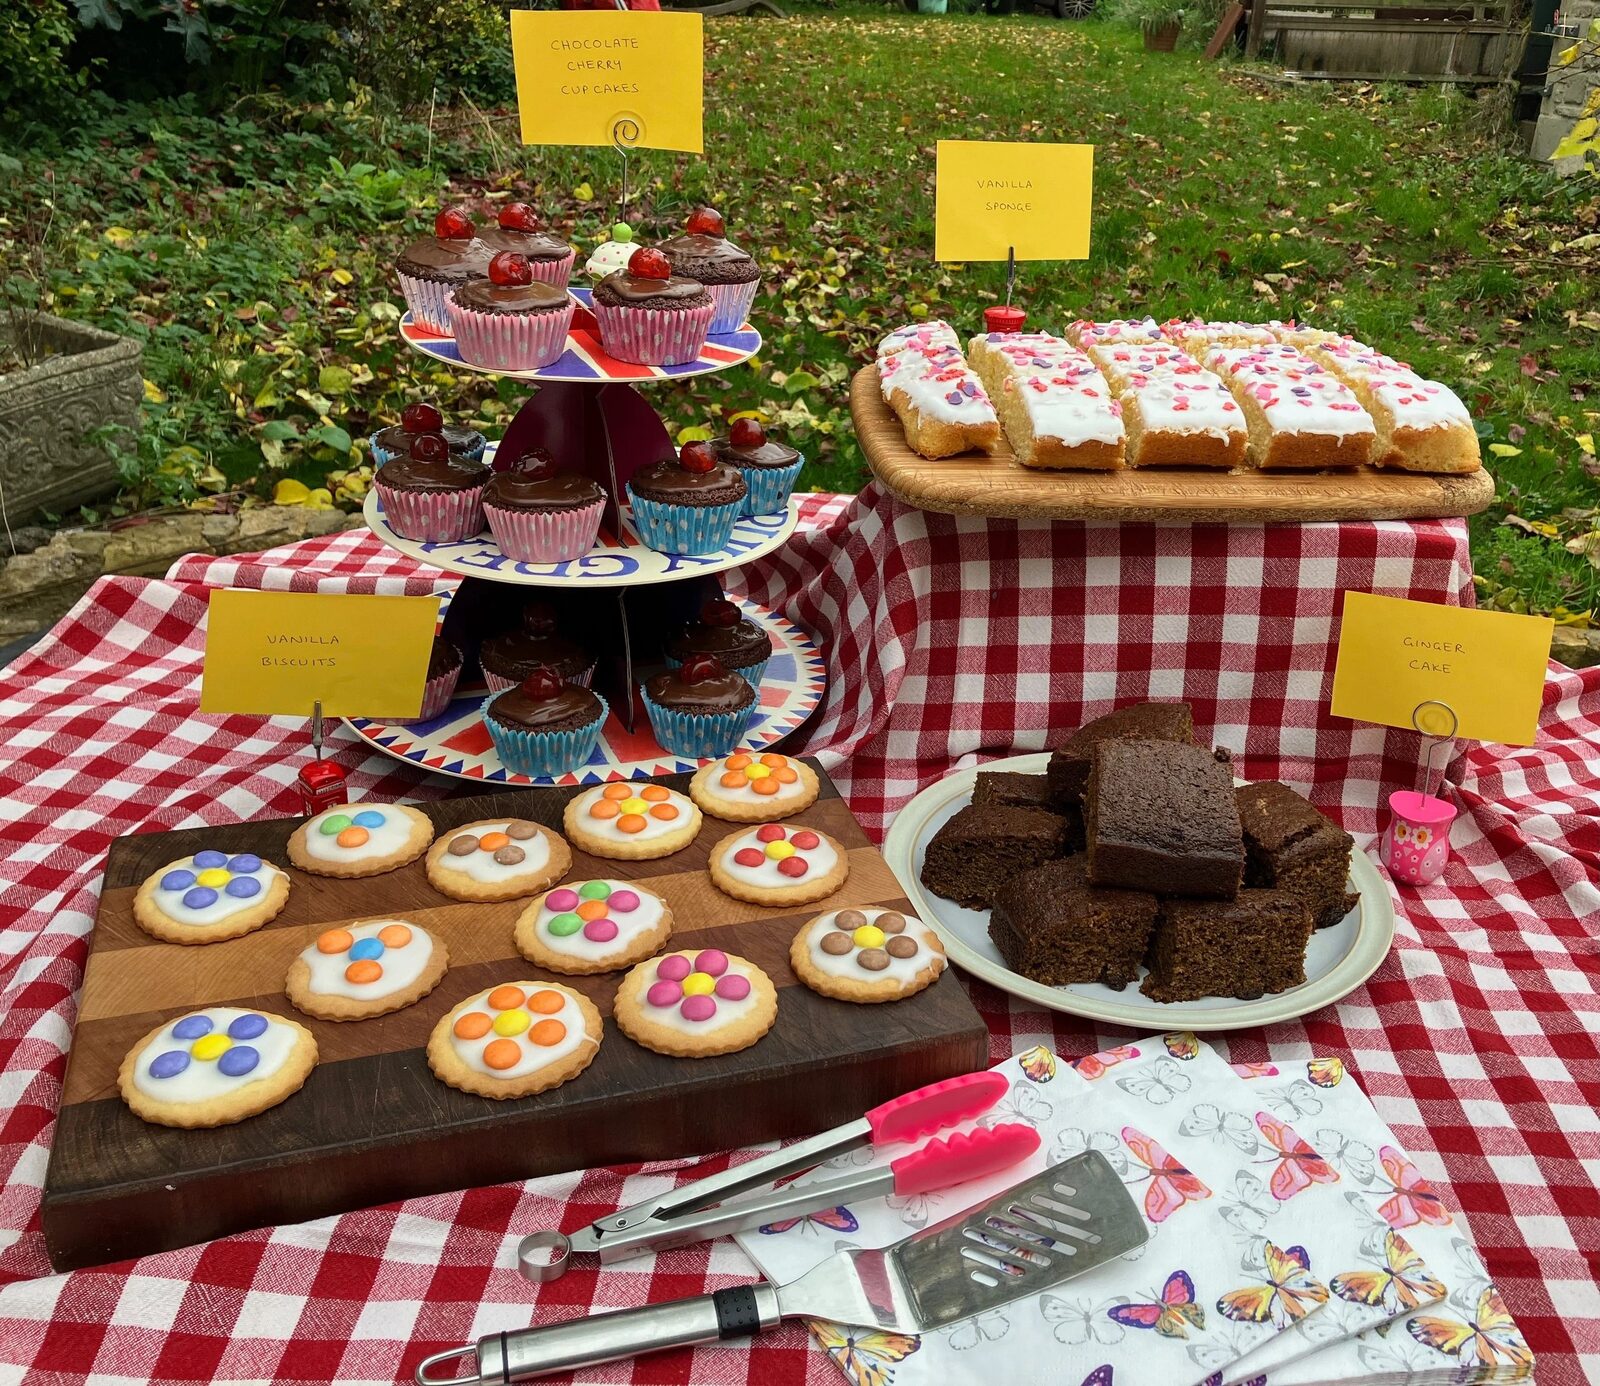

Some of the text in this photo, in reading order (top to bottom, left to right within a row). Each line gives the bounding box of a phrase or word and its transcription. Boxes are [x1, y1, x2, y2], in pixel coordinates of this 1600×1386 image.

[550, 37, 639, 51] CHOCOLATE
[567, 60, 622, 72] CHERRY
[976, 179, 1033, 189] VANILLA
[985, 202, 1032, 212] SPONGE
[266, 634, 340, 645] VANILLA
[1403, 636, 1466, 655] GINGER
[261, 656, 336, 667] BISCUITS
[1409, 659, 1451, 674] CAKE
